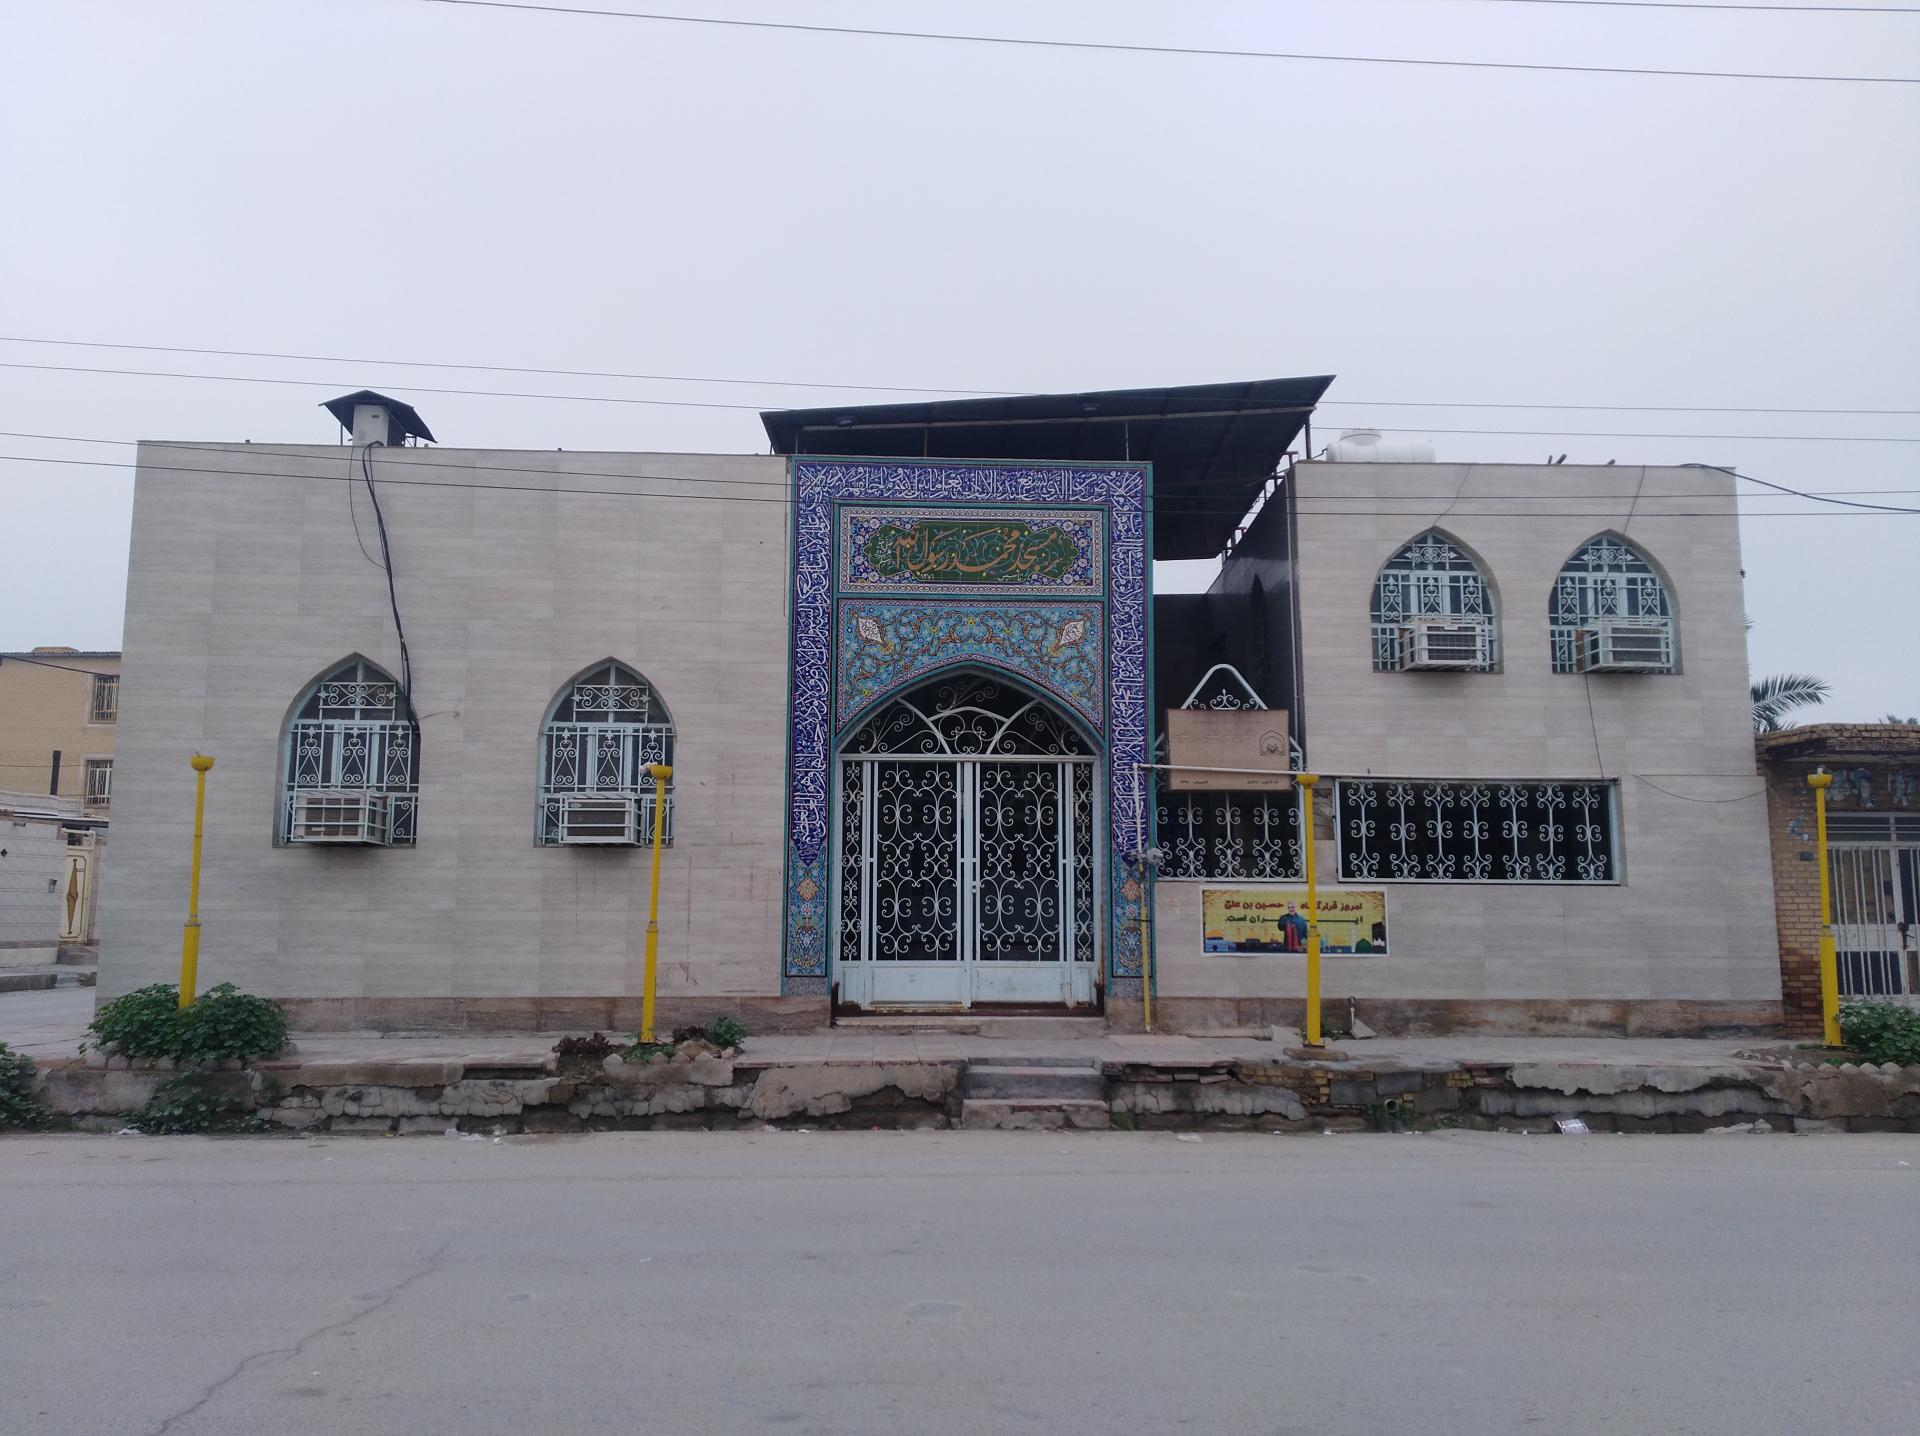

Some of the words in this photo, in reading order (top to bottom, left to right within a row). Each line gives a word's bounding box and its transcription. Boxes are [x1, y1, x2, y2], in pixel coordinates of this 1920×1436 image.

[1001, 531, 1063, 573] مسجد
[1242, 902, 1254, 911] بن
[1255, 902, 1285, 911] حسین
[1340, 902, 1362, 911] امروز
